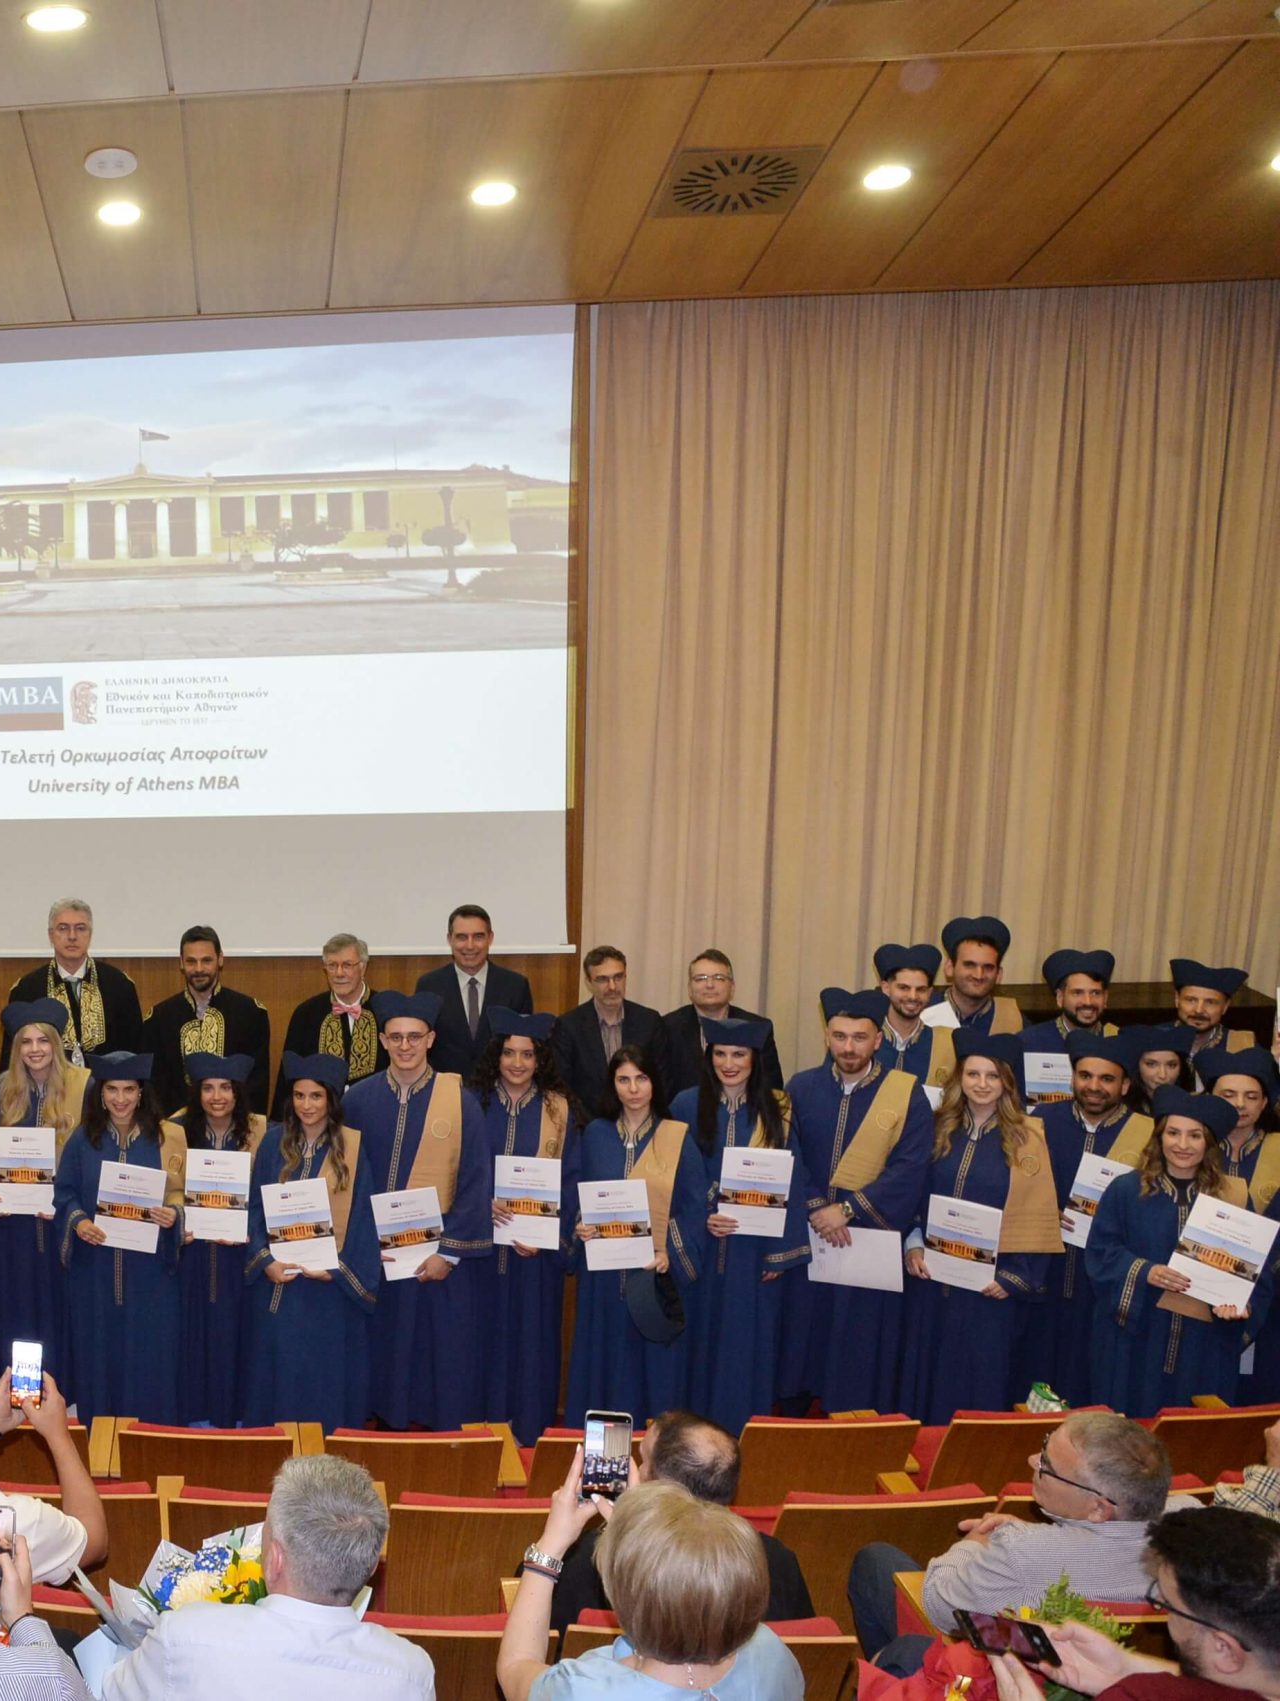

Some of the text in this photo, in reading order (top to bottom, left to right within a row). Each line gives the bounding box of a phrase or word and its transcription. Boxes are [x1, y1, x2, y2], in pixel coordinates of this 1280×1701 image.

[105, 676, 229, 687] ΕΛΛΗΝΙΚΗ ΔΗΜΟΚΡΑΤΙΑ
[0, 745, 268, 767] Τελετή Ορκωμοσίας Αποφοίτων
[28, 775, 241, 796] University of Athens MBA
